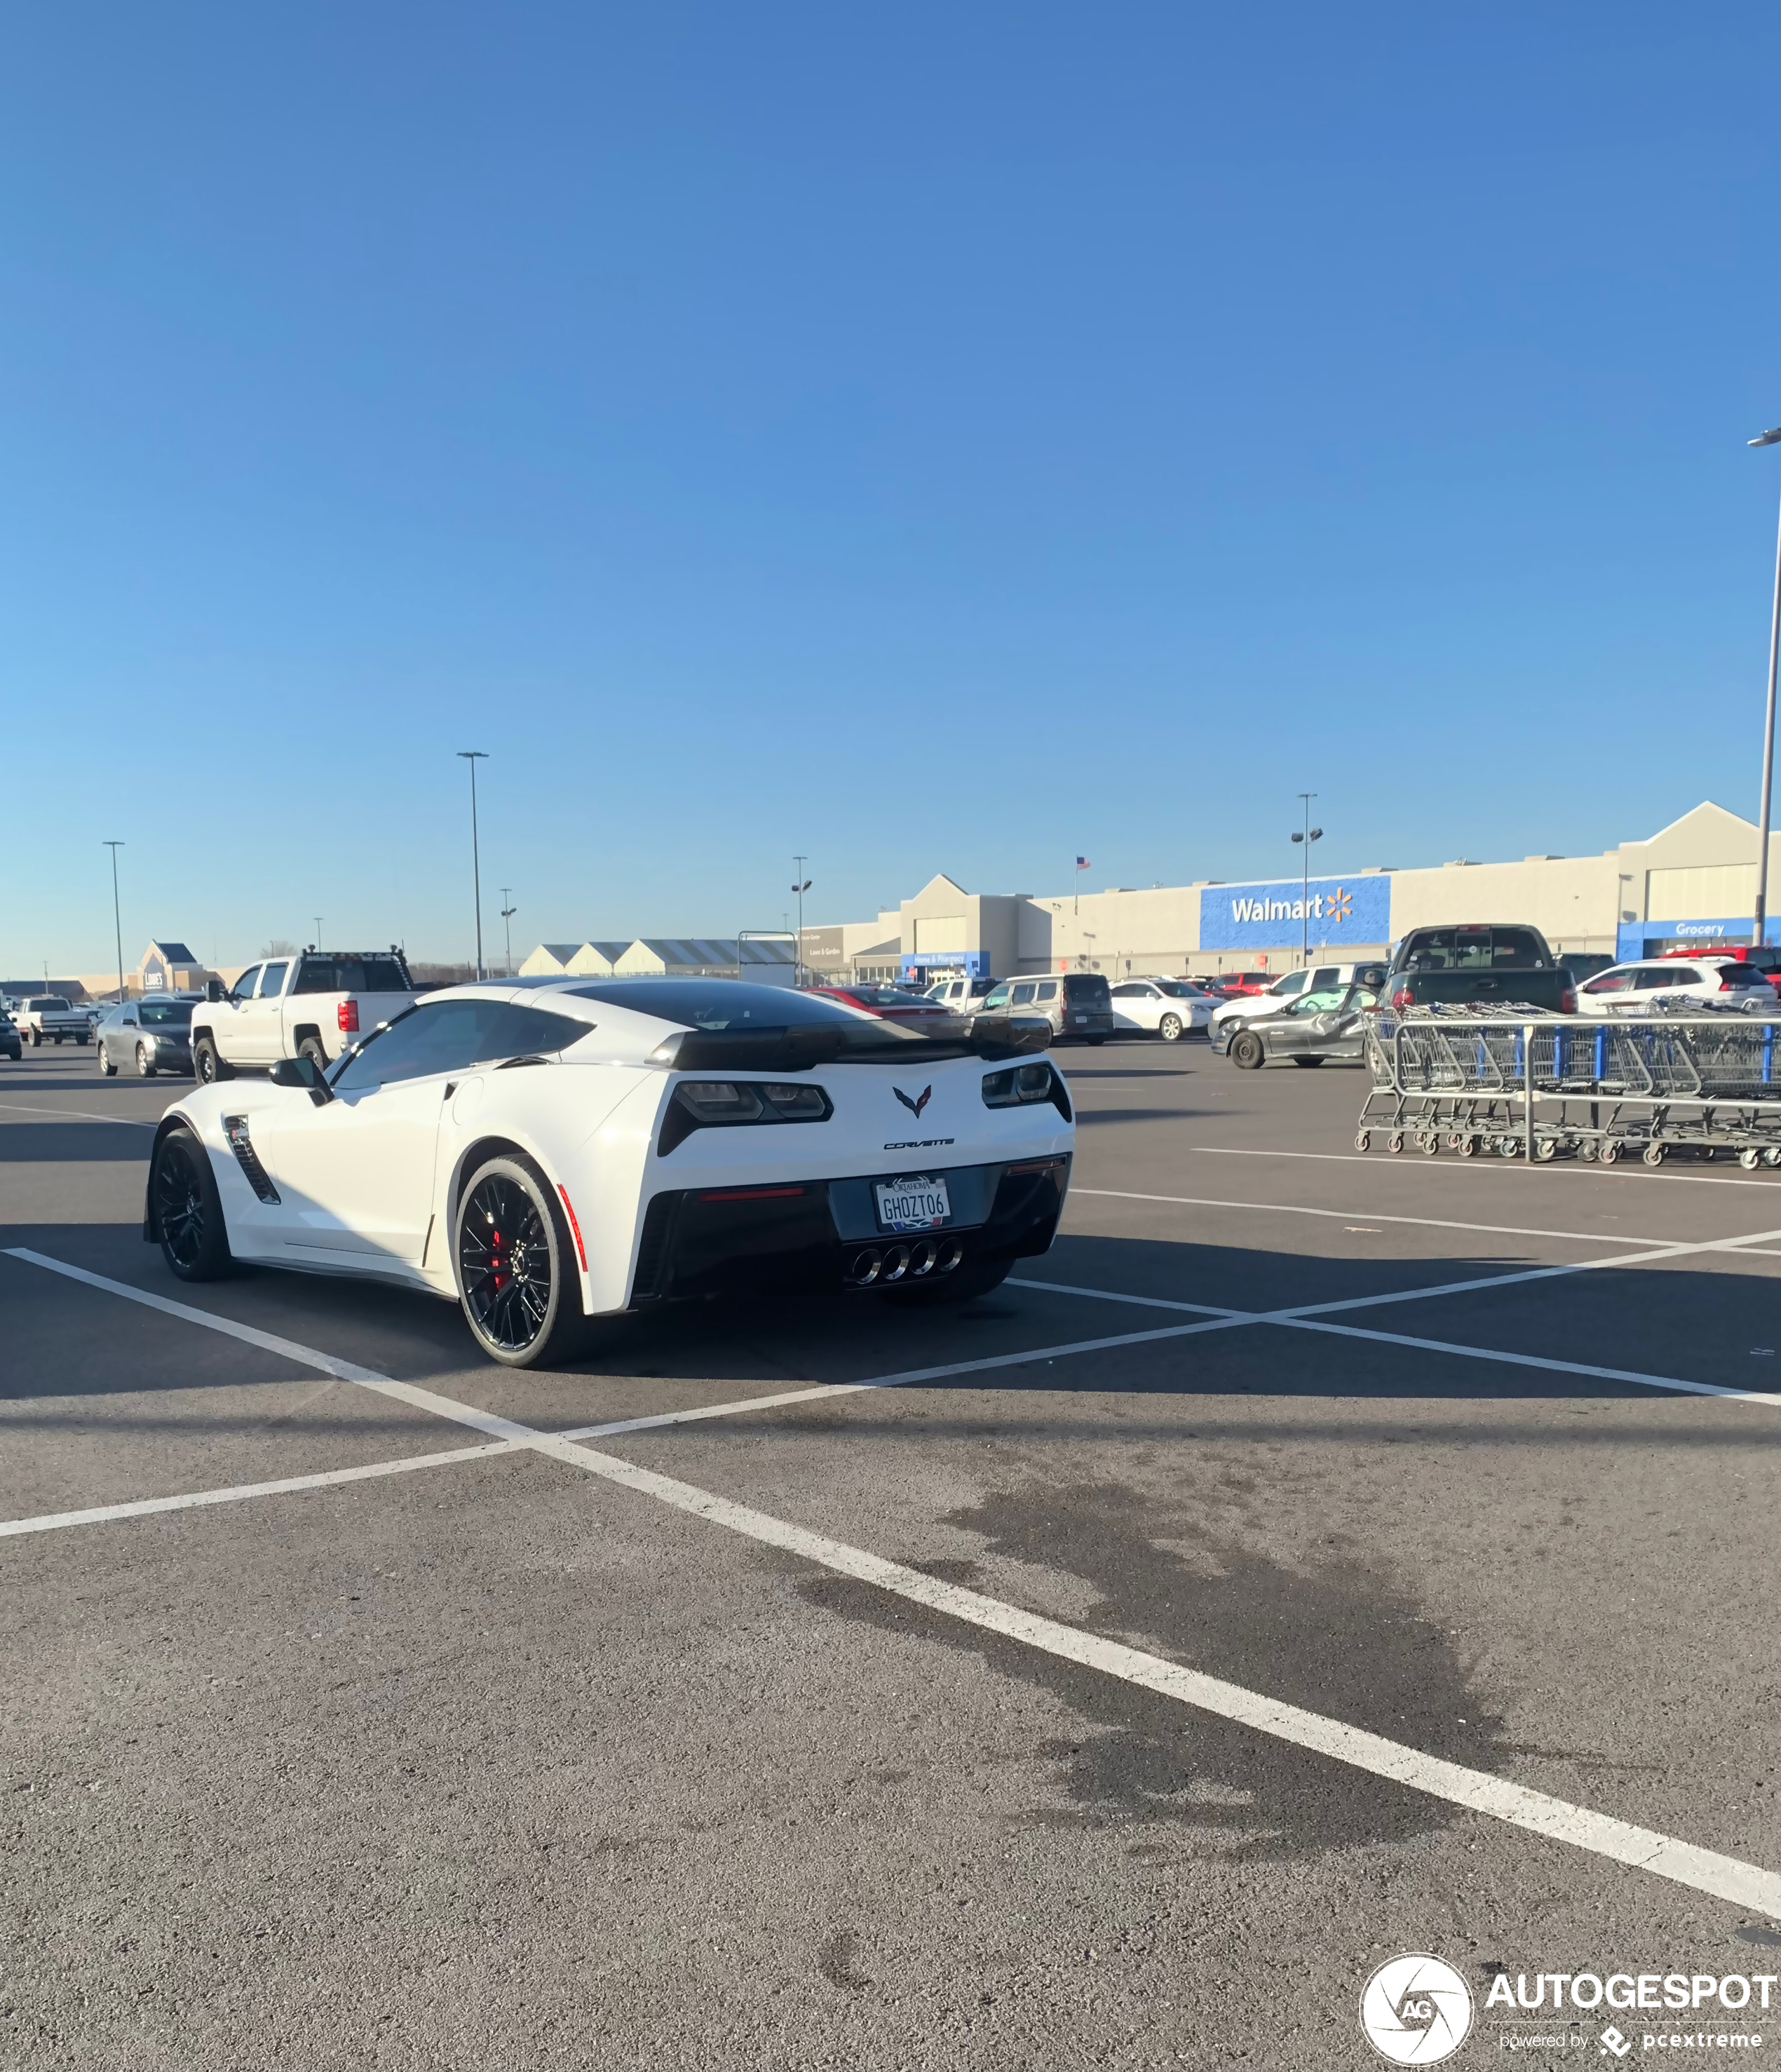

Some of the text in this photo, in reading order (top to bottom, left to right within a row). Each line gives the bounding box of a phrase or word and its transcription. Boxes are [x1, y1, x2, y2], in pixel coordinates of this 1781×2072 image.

[1232, 893, 1323, 923] Walmart
[1676, 923, 1724, 937] Grocery
[932, 955, 936, 963] &
[937, 955, 964, 963] Pharmacy
[883, 1138, 955, 1150] CORVETTE
[893, 1181, 930, 1193] OKLAHOMA
